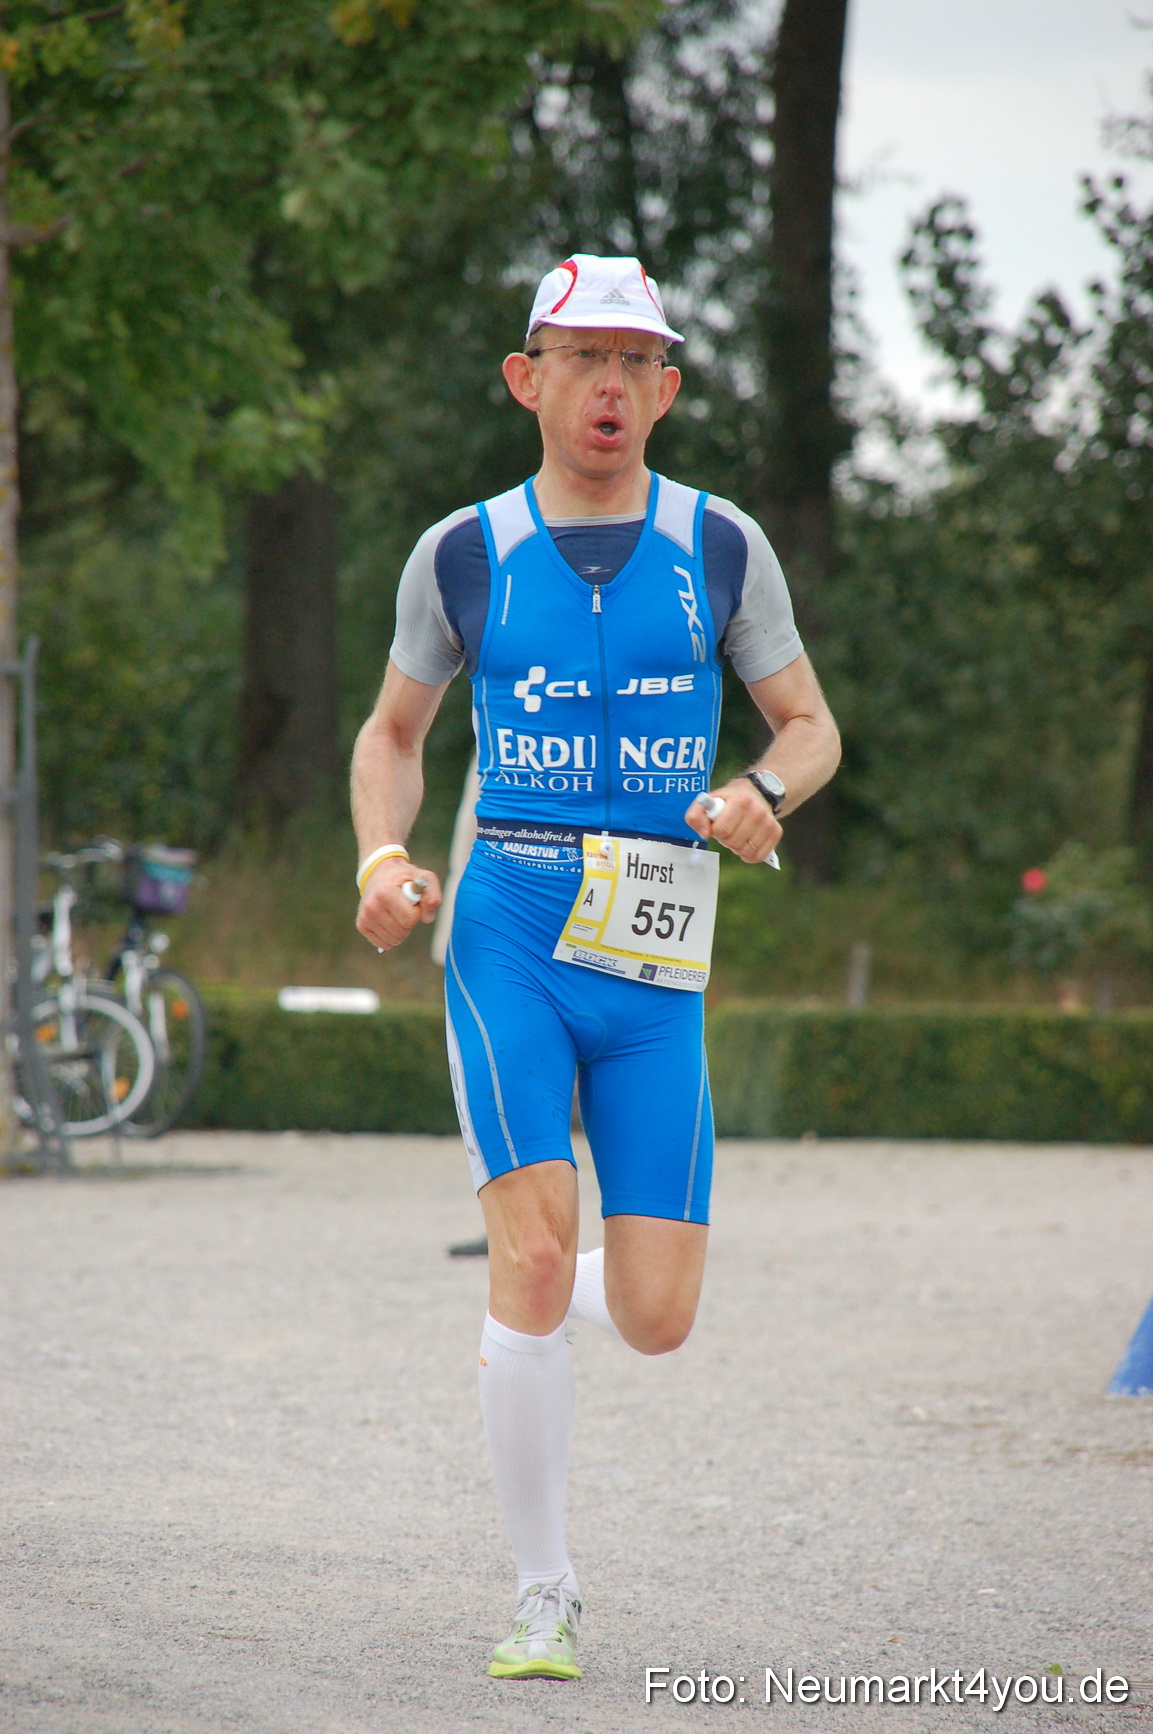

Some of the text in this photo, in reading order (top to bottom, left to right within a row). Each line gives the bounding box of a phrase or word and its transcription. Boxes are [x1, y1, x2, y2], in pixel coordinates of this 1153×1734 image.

[673, 565, 706, 663] 2XU
[626, 852, 674, 885] Horst
[582, 888, 594, 907] A
[631, 899, 695, 942] 557
[659, 966, 707, 983] PFLEIDERER
